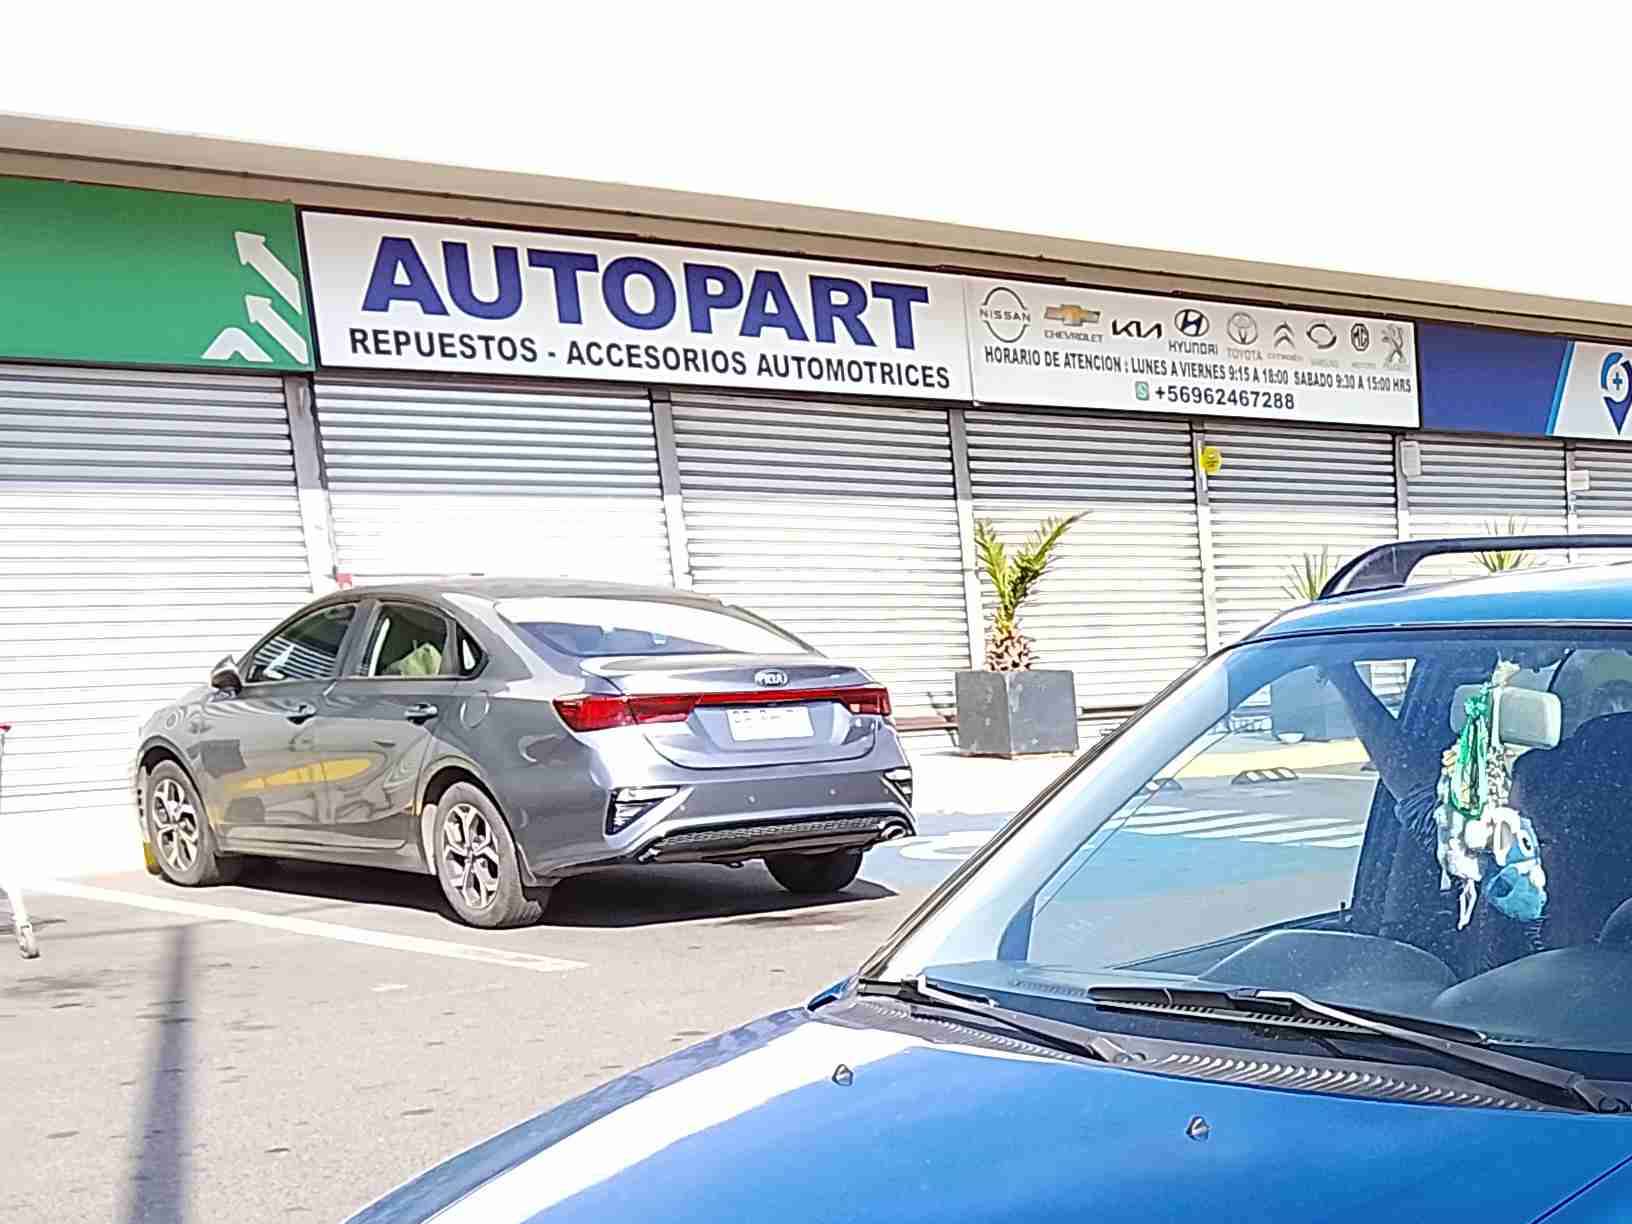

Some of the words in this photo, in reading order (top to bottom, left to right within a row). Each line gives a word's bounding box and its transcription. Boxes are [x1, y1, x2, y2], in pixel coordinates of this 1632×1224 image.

[361, 235, 930, 350] AUTOPART
[980, 308, 1031, 322] NISSAN
[1044, 329, 1104, 343] CHEVROLET
[1168, 340, 1219, 356] HYUNDAI
[1227, 349, 1263, 361] TOYOTA
[350, 327, 538, 363] REPUESTOS
[566, 340, 748, 378] ACCESORIOS
[756, 352, 950, 390] AUTOMOTRICES
[984, 345, 1041, 367] HORARIO
[1044, 351, 1060, 367] DE
[1063, 352, 1122, 373] ATENCION
[1131, 357, 1168, 376] LUNES
[1170, 361, 1179, 377] A
[1179, 361, 1226, 381] VIERNES
[1228, 362, 1250, 381] 9:15
[1252, 364, 1260, 382] A
[1294, 368, 1334, 388] SABADO
[1357, 375, 1365, 390] A
[1393, 378, 1411, 393] HRS
[1155, 386, 1295, 411] +56962467288
